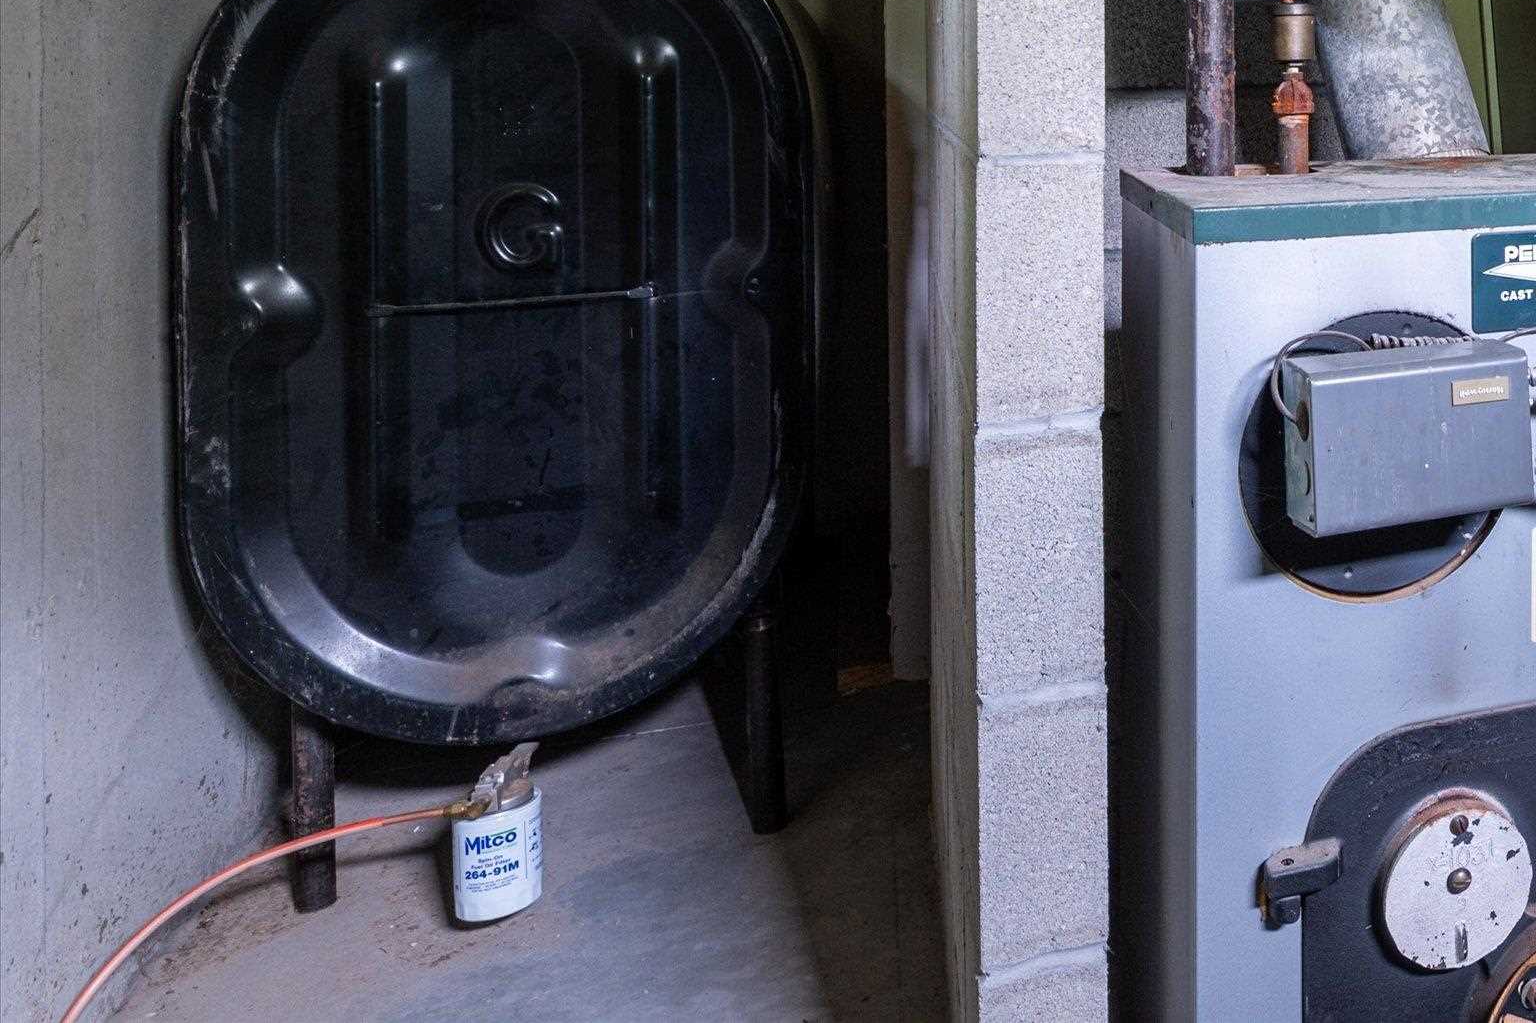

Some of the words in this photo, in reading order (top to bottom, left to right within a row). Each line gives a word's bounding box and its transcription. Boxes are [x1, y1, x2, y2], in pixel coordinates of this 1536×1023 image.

[474, 182, 563, 270] G
[1500, 289, 1533, 302] CAST
[464, 831, 518, 856] Mitco
[464, 860, 520, 880] 264-91M
